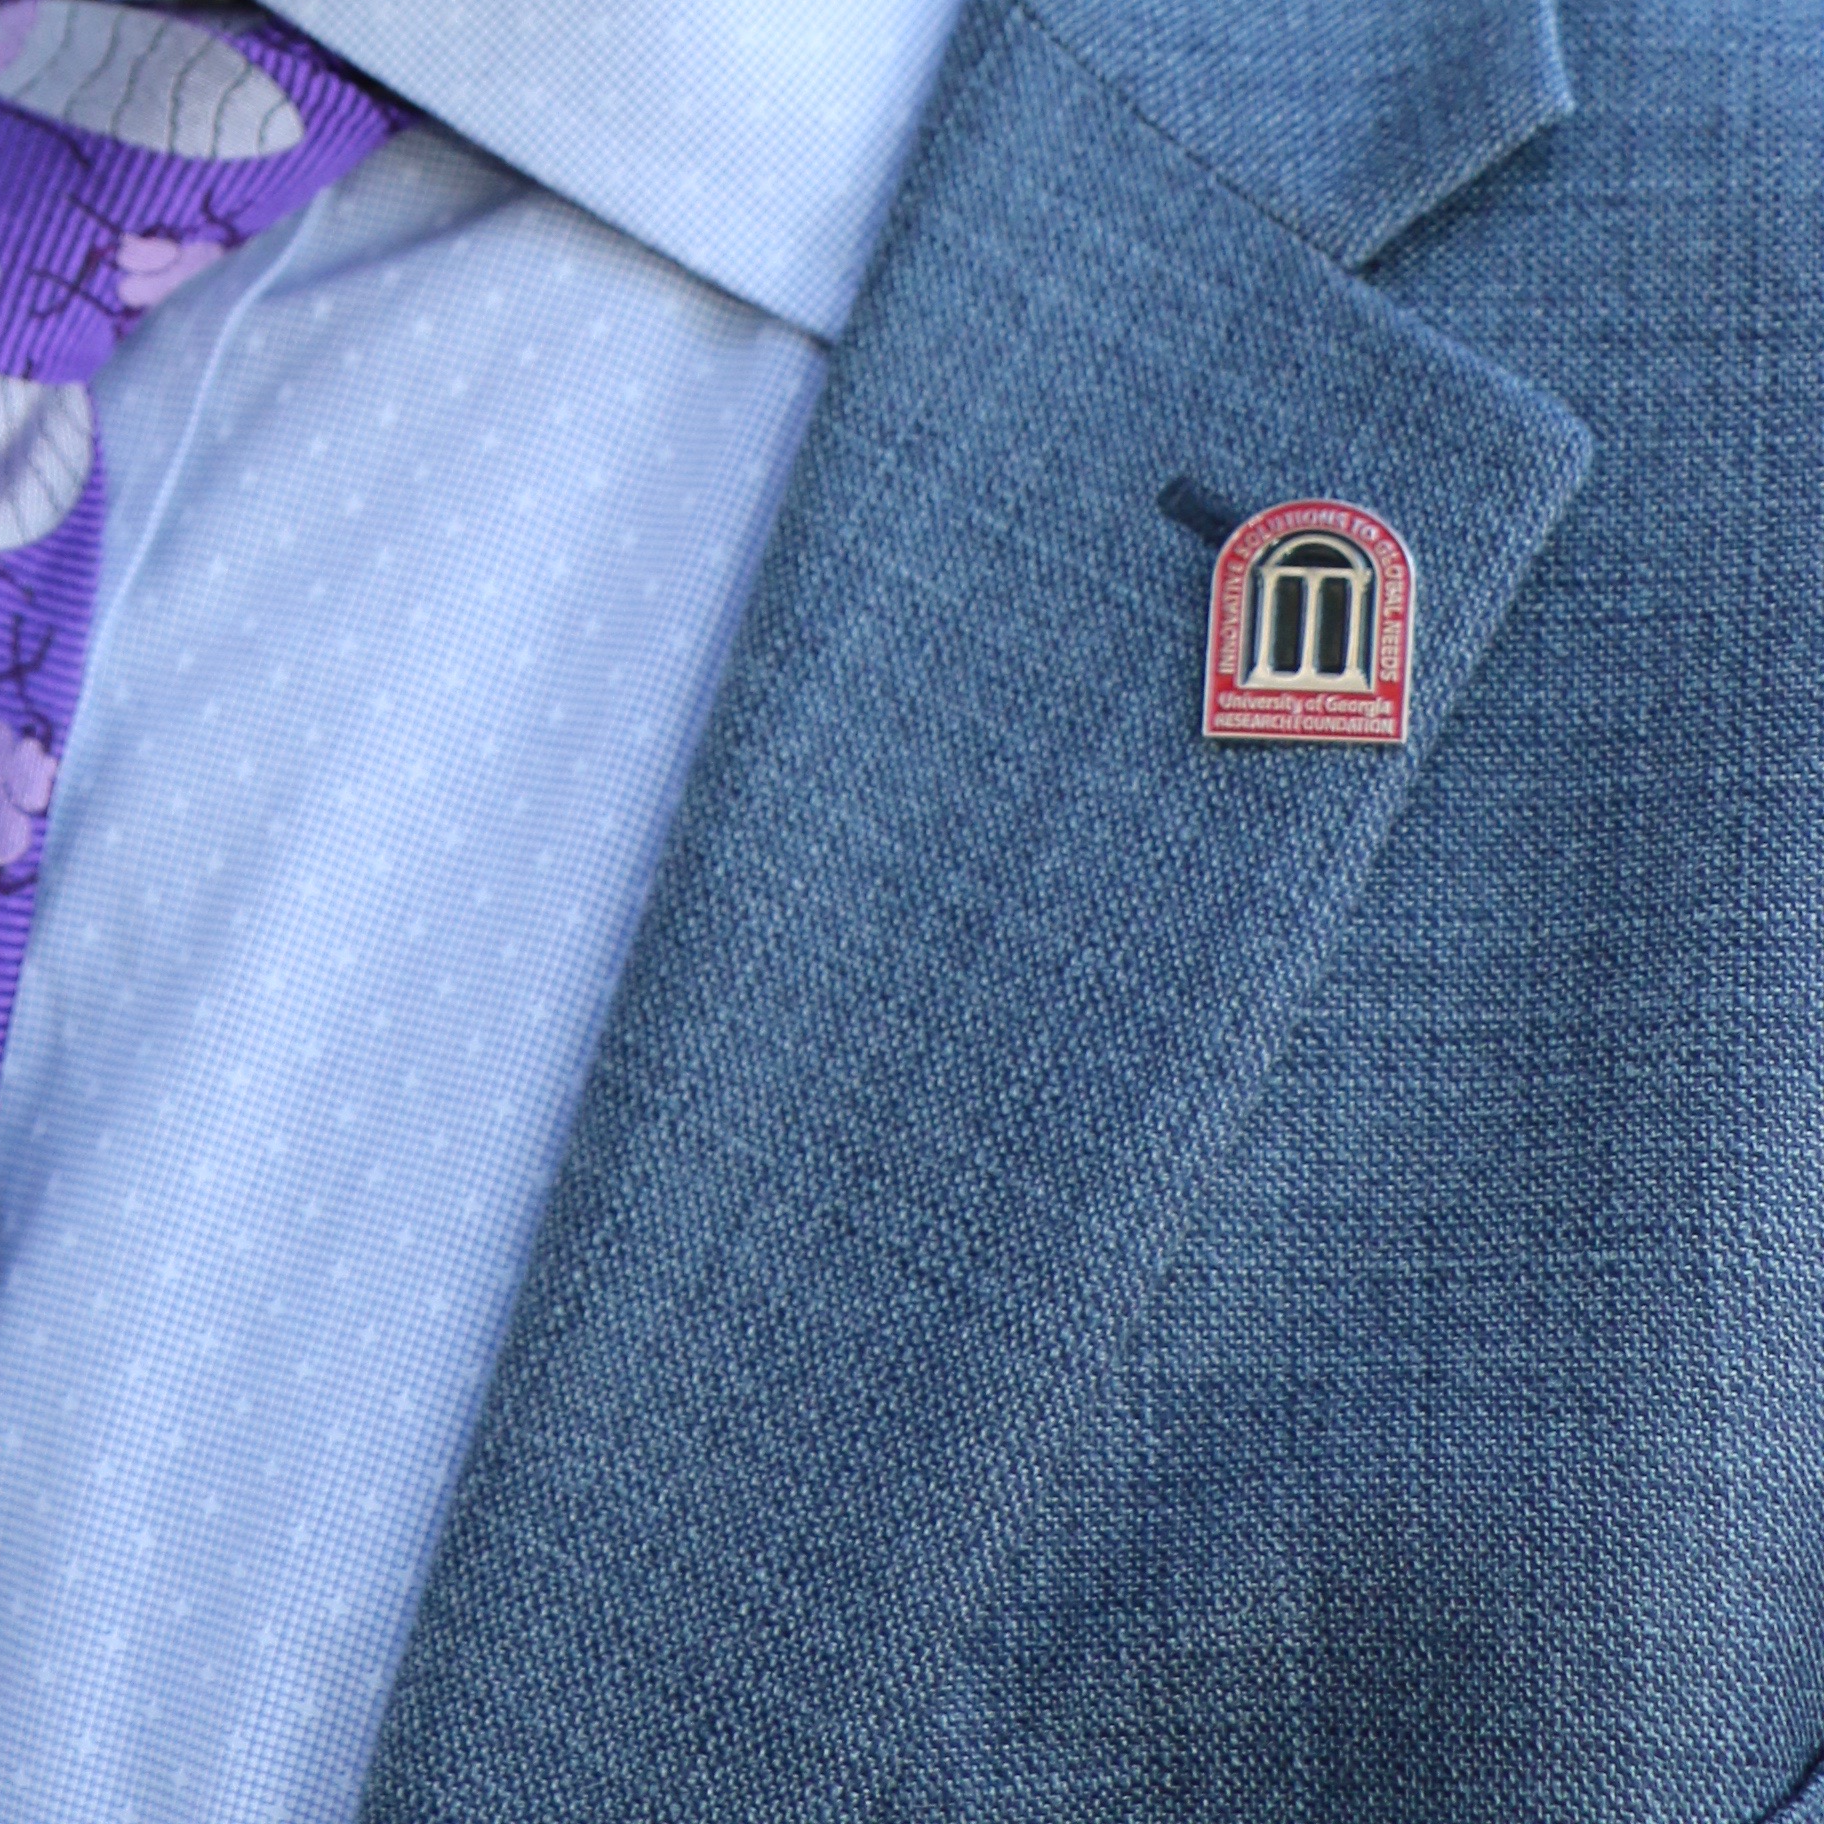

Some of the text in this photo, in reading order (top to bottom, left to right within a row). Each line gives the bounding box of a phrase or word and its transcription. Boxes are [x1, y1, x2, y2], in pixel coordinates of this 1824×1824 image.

[1218, 510, 1406, 683] INNOVATIVE SOLUTIONS TO GLOBAL NEEDS
[1218, 692, 1393, 717] University of Georgia
[1214, 712, 1394, 735] RESEARCH FOUNDATION
